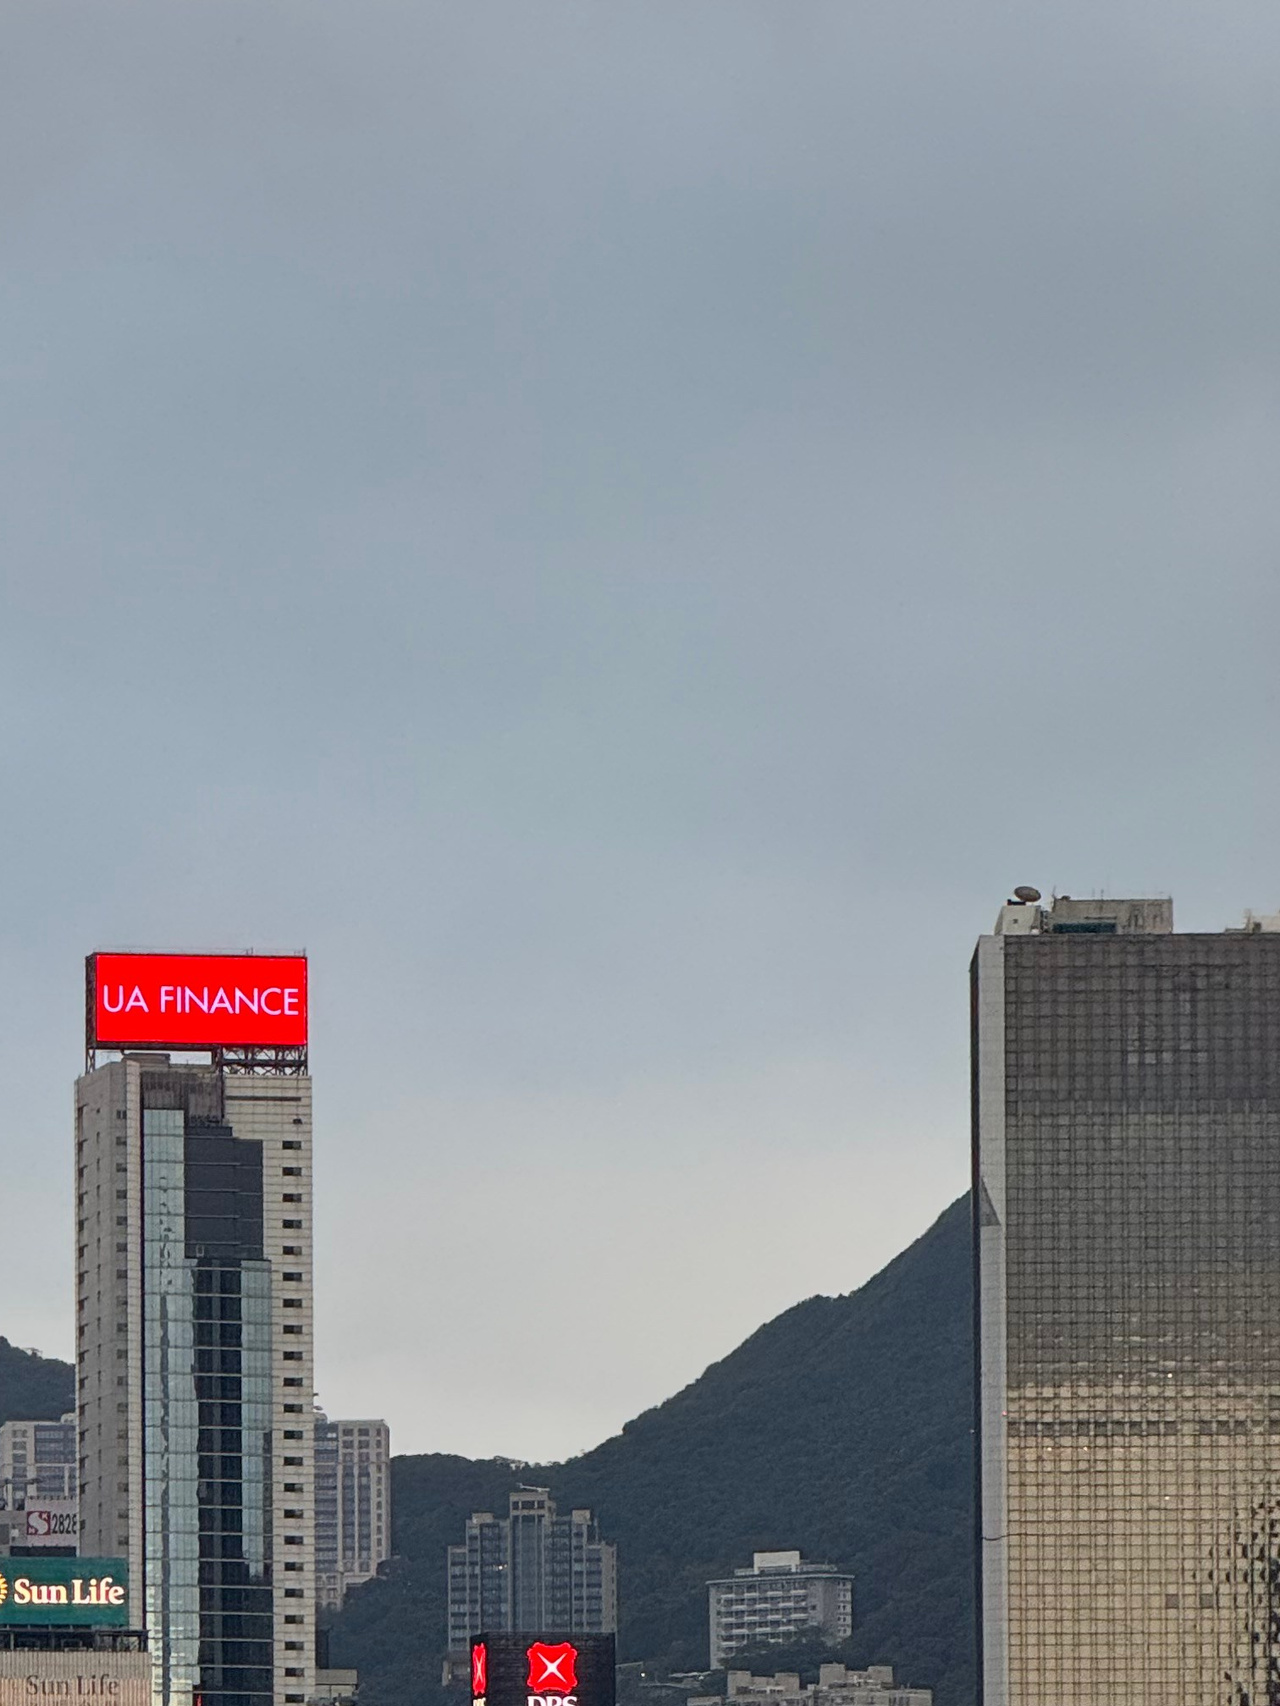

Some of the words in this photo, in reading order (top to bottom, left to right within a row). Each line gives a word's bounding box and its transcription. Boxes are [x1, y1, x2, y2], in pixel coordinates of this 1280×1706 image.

[103, 985, 149, 1013] UA
[160, 986, 299, 1015] FINANCE
[14, 1578, 68, 1605] Sun
[72, 1576, 125, 1605] Life
[26, 1675, 68, 1696] Sun
[77, 1674, 120, 1696] Life
